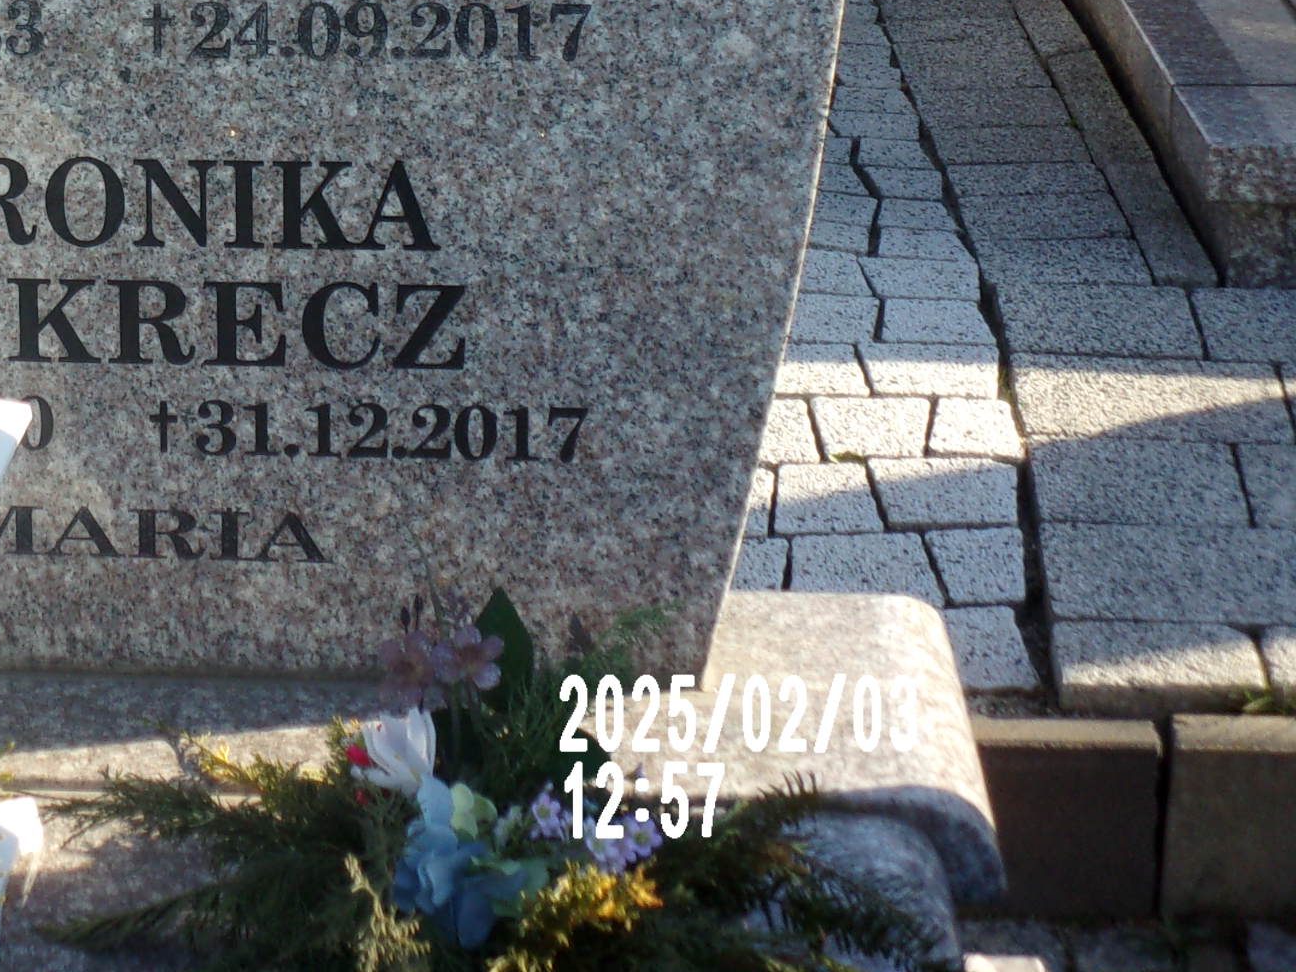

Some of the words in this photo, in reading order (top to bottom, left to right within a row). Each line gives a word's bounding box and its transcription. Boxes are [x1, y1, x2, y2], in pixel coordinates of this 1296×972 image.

[192, 2, 592, 62] 24.09.2017
[8, 278, 466, 372] KRECZ
[195, 401, 588, 464] 31.12.2017
